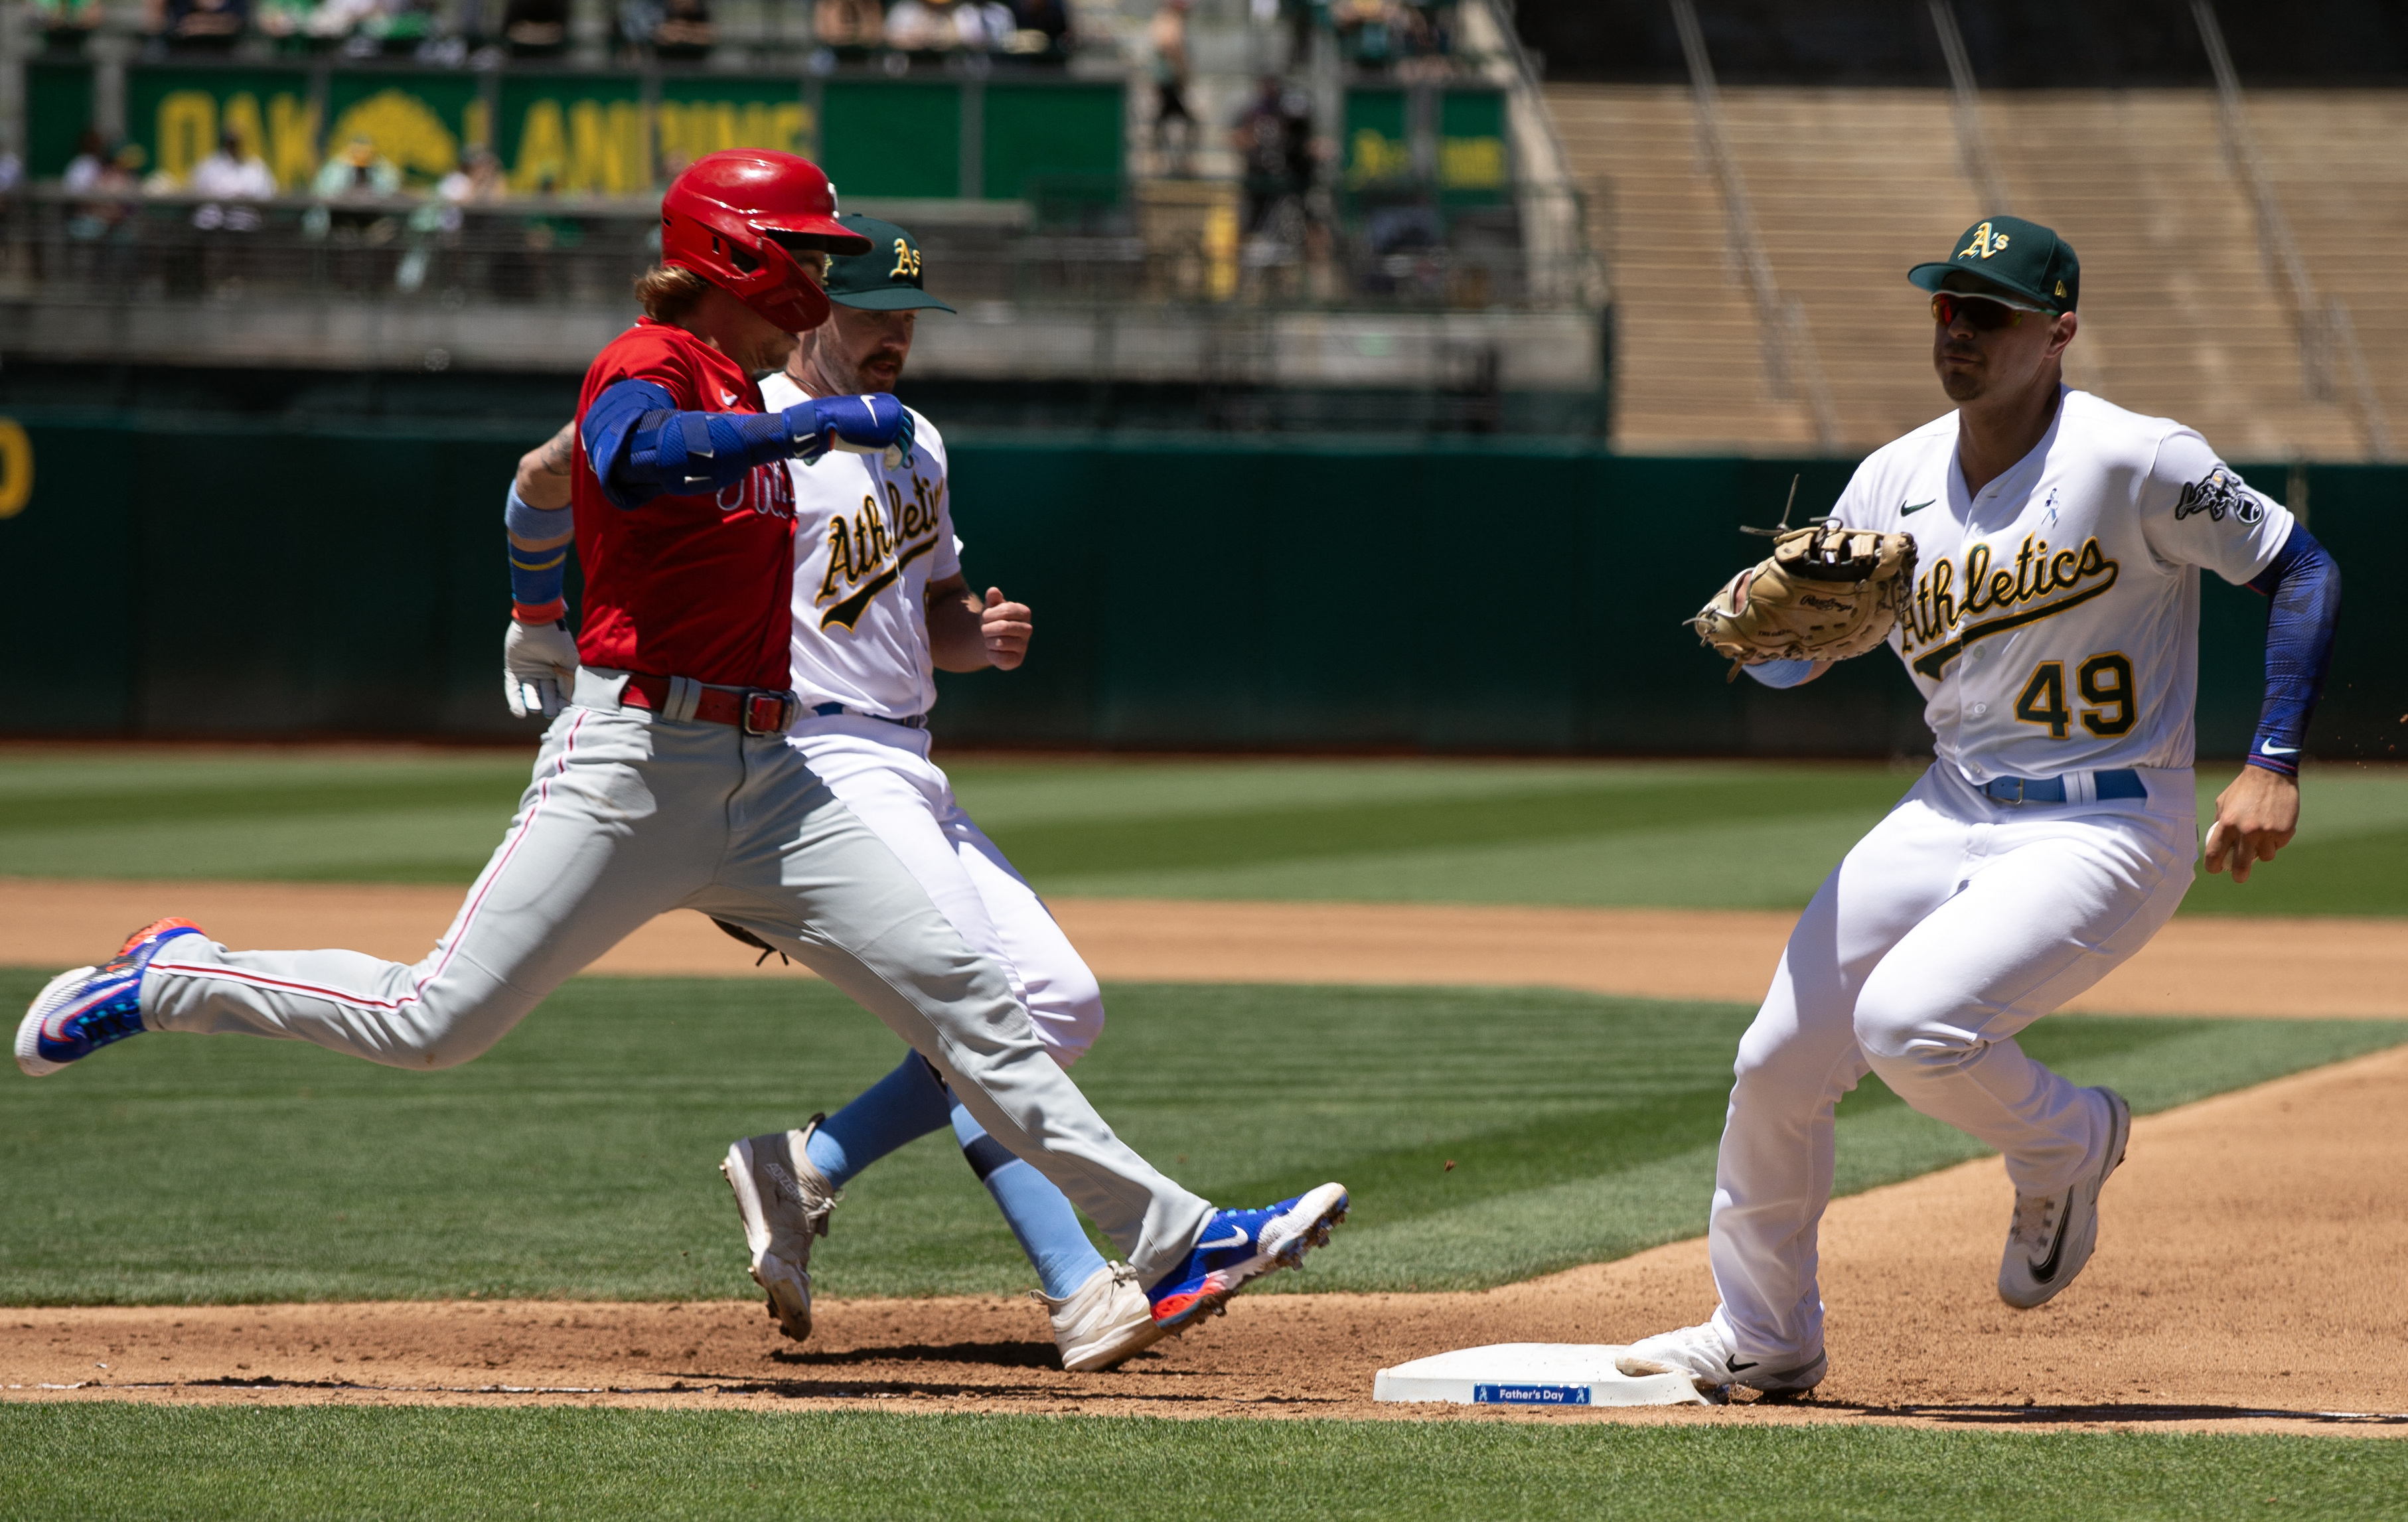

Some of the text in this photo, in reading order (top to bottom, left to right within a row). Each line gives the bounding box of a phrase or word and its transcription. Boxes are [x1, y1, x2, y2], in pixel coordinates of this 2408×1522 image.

[1958, 222, 2010, 260] A's
[1902, 530, 2105, 657] Athletics
[2013, 650, 2138, 739] 49
[1499, 1389, 1564, 1402] Father's Day
